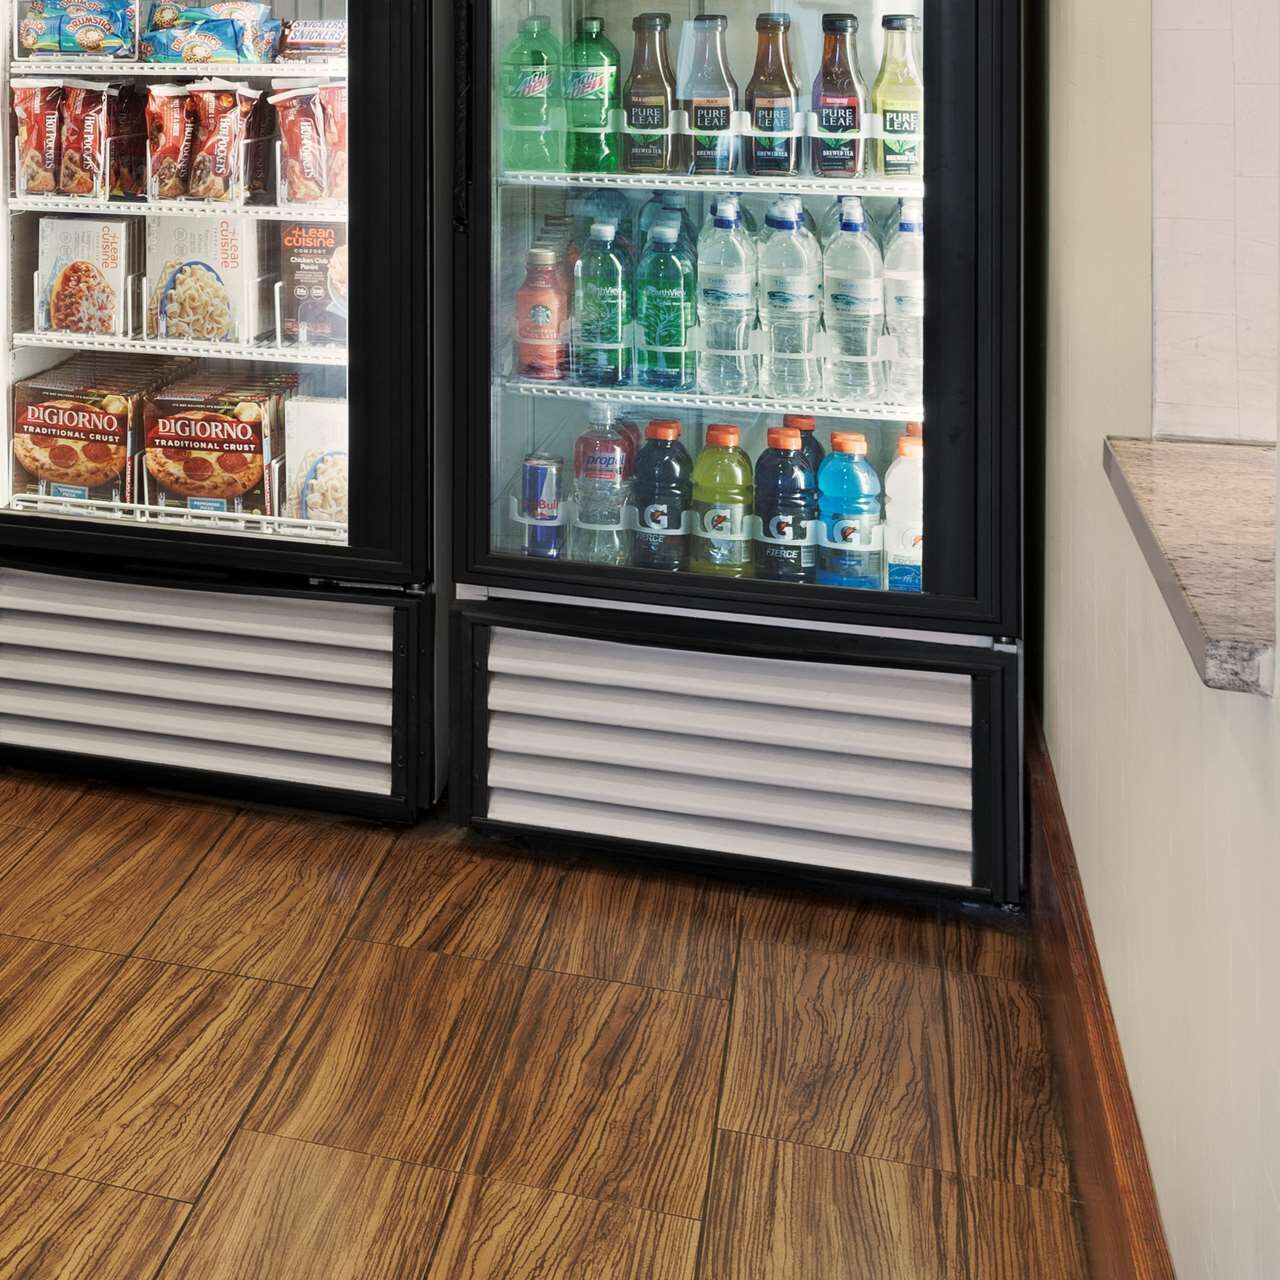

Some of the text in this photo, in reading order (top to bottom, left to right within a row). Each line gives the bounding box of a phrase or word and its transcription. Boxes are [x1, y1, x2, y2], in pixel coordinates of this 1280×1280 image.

[67, 15, 113, 34] DRUMSTICK
[290, 29, 344, 41] SNICKERS
[631, 106, 661, 119] PURE
[697, 108, 727, 119] PURE
[758, 109, 788, 120] PURE
[822, 108, 852, 119] PURE
[886, 112, 918, 122] PURE
[45, 113, 56, 131] HOT
[632, 116, 661, 126] LEAF
[697, 117, 727, 127] LEAF
[101, 225, 110, 269] cuisine
[220, 221, 229, 269] cuisine
[283, 236, 335, 248] cuisine
[23, 425, 120, 443] TRADITIONAL CRUST
[154, 439, 256, 452] TRADITIONAL CRUST
[645, 504, 668, 529] G
[703, 508, 730, 534] G
